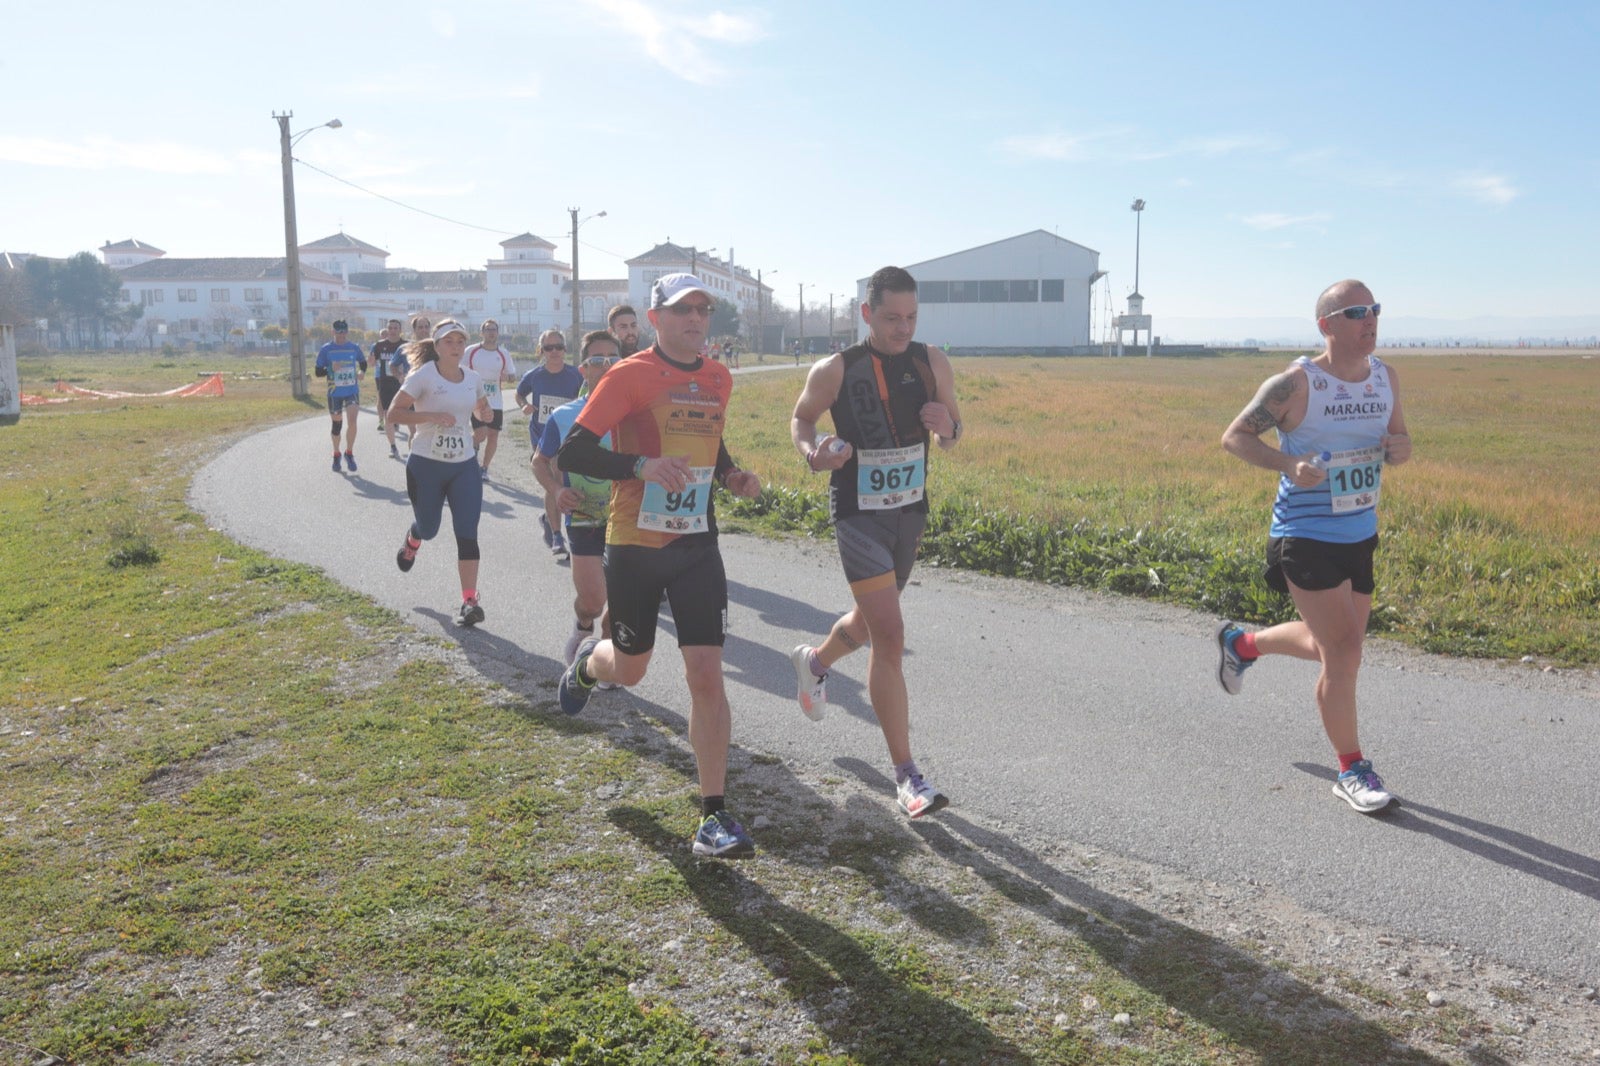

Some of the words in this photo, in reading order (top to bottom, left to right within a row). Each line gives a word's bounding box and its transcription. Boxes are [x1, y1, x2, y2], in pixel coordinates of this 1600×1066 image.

[436, 435, 464, 449] 3131
[870, 464, 915, 491] 967
[665, 489, 697, 512] 94
